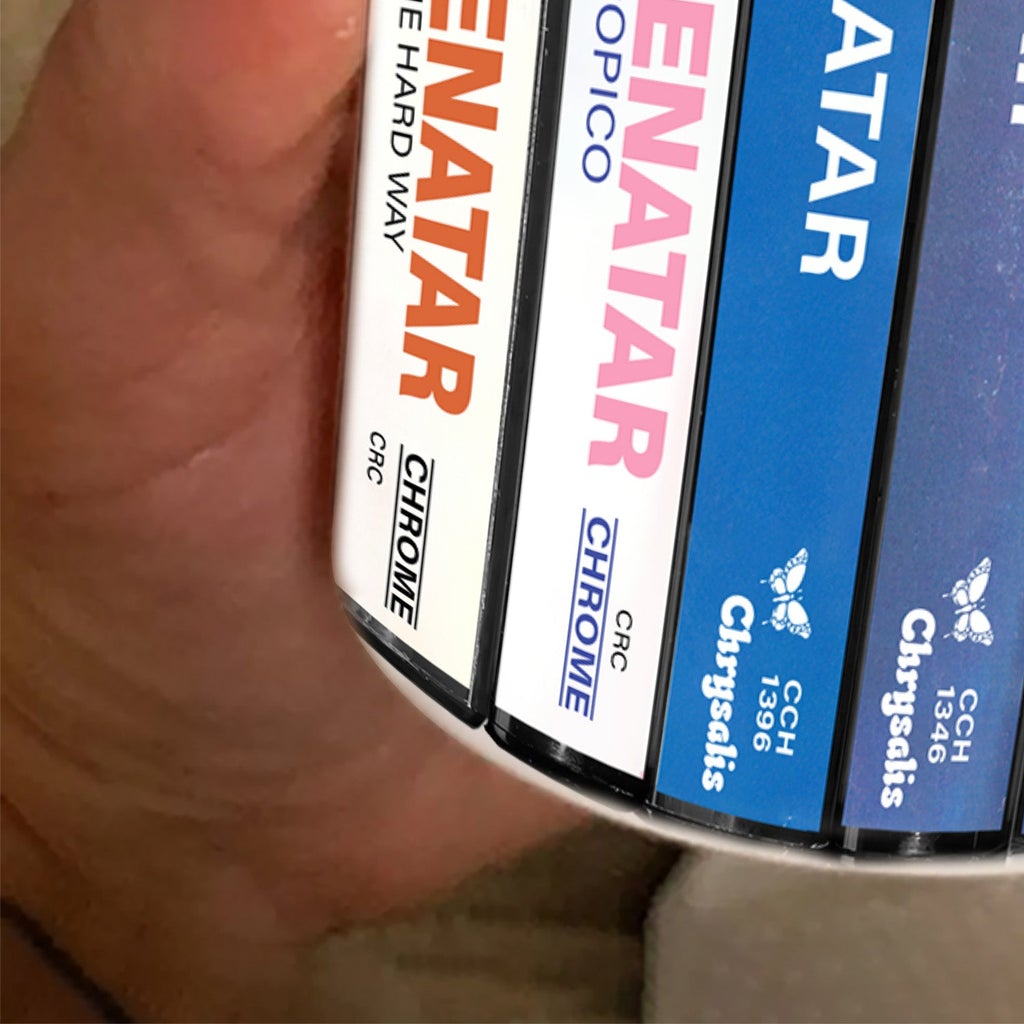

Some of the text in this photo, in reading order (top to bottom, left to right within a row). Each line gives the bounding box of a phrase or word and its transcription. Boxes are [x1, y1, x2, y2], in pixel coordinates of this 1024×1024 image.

[390, 43, 420, 159] HARD
[383, 172, 411, 254] WAY
[366, 431, 387, 486] CRC
[388, 452, 430, 627] CHROME
[563, 516, 612, 721] CHROME
[609, 609, 634, 673] CRC
[701, 594, 755, 793] Chrysalis
[752, 673, 780, 752] 1396
[775, 679, 803, 757] CCH
[880, 607, 936, 809] Chrysalis
[927, 685, 957, 765] 1346
[950, 687, 979, 763] CCH
